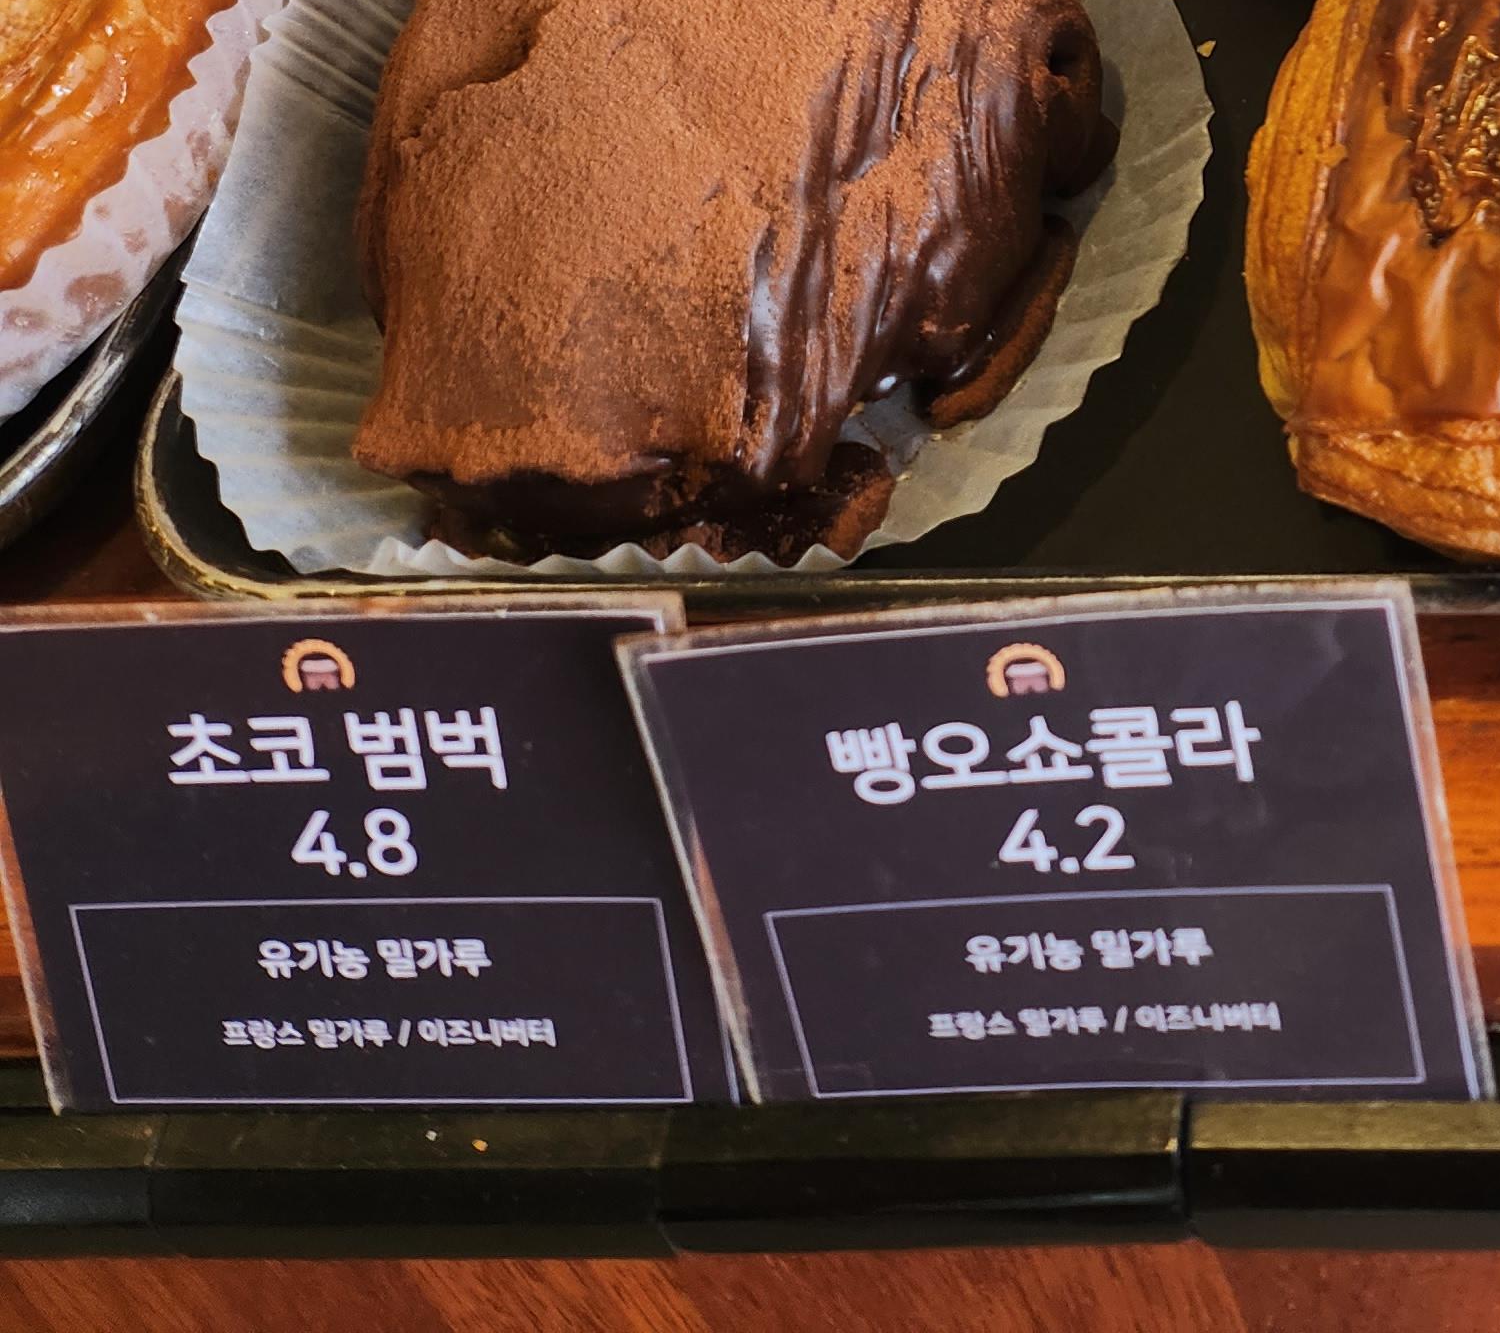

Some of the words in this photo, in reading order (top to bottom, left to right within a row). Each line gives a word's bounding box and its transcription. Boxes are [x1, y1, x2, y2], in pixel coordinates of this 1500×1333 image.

[168, 713, 330, 785] 초코
[344, 707, 508, 791] 범벅
[826, 700, 1262, 805] 빵오쇼콜라
[291, 808, 418, 878] 4.8
[999, 804, 1135, 874] 4.2
[258, 939, 371, 980] 유기농
[376, 938, 492, 979] 밀가루
[965, 932, 1084, 974] 유기농
[1090, 927, 1213, 969] 밀가루
[221, 1019, 306, 1049] 프랑스
[307, 1018, 393, 1049] 밀가루
[397, 1018, 412, 1048] /
[417, 1018, 557, 1048] 이즈니버터
[928, 1010, 1016, 1040] 프랑스
[1017, 1006, 1108, 1038] 밀가루
[1113, 1005, 1129, 1033] /
[1135, 1001, 1281, 1032] 이즈니버터
